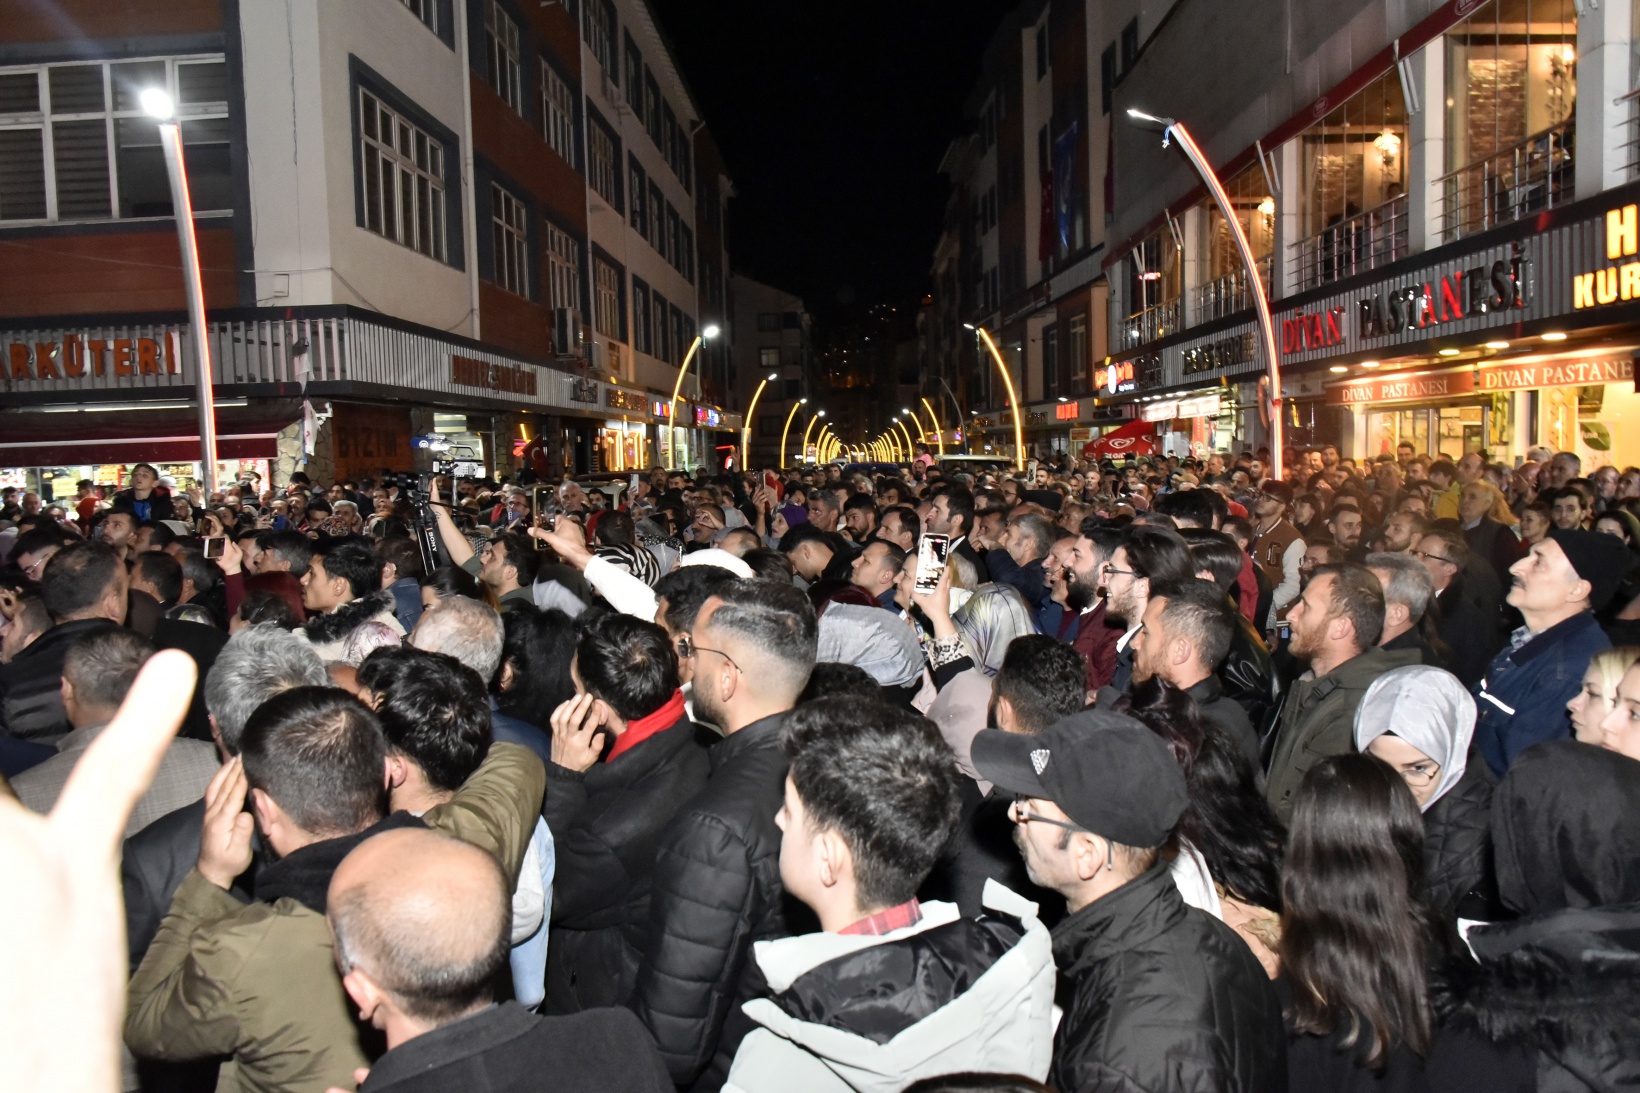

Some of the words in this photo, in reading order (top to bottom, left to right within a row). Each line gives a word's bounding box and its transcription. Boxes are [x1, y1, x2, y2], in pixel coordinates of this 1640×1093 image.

[1360, 240, 1525, 338] PASTANESİ
[1342, 385, 1373, 402] DİVAN
[1381, 376, 1448, 398] PASTANESİ
[1485, 368, 1536, 388] DİVAN
[428, 531, 437, 552] SONY
[1266, 541, 1281, 567] G
